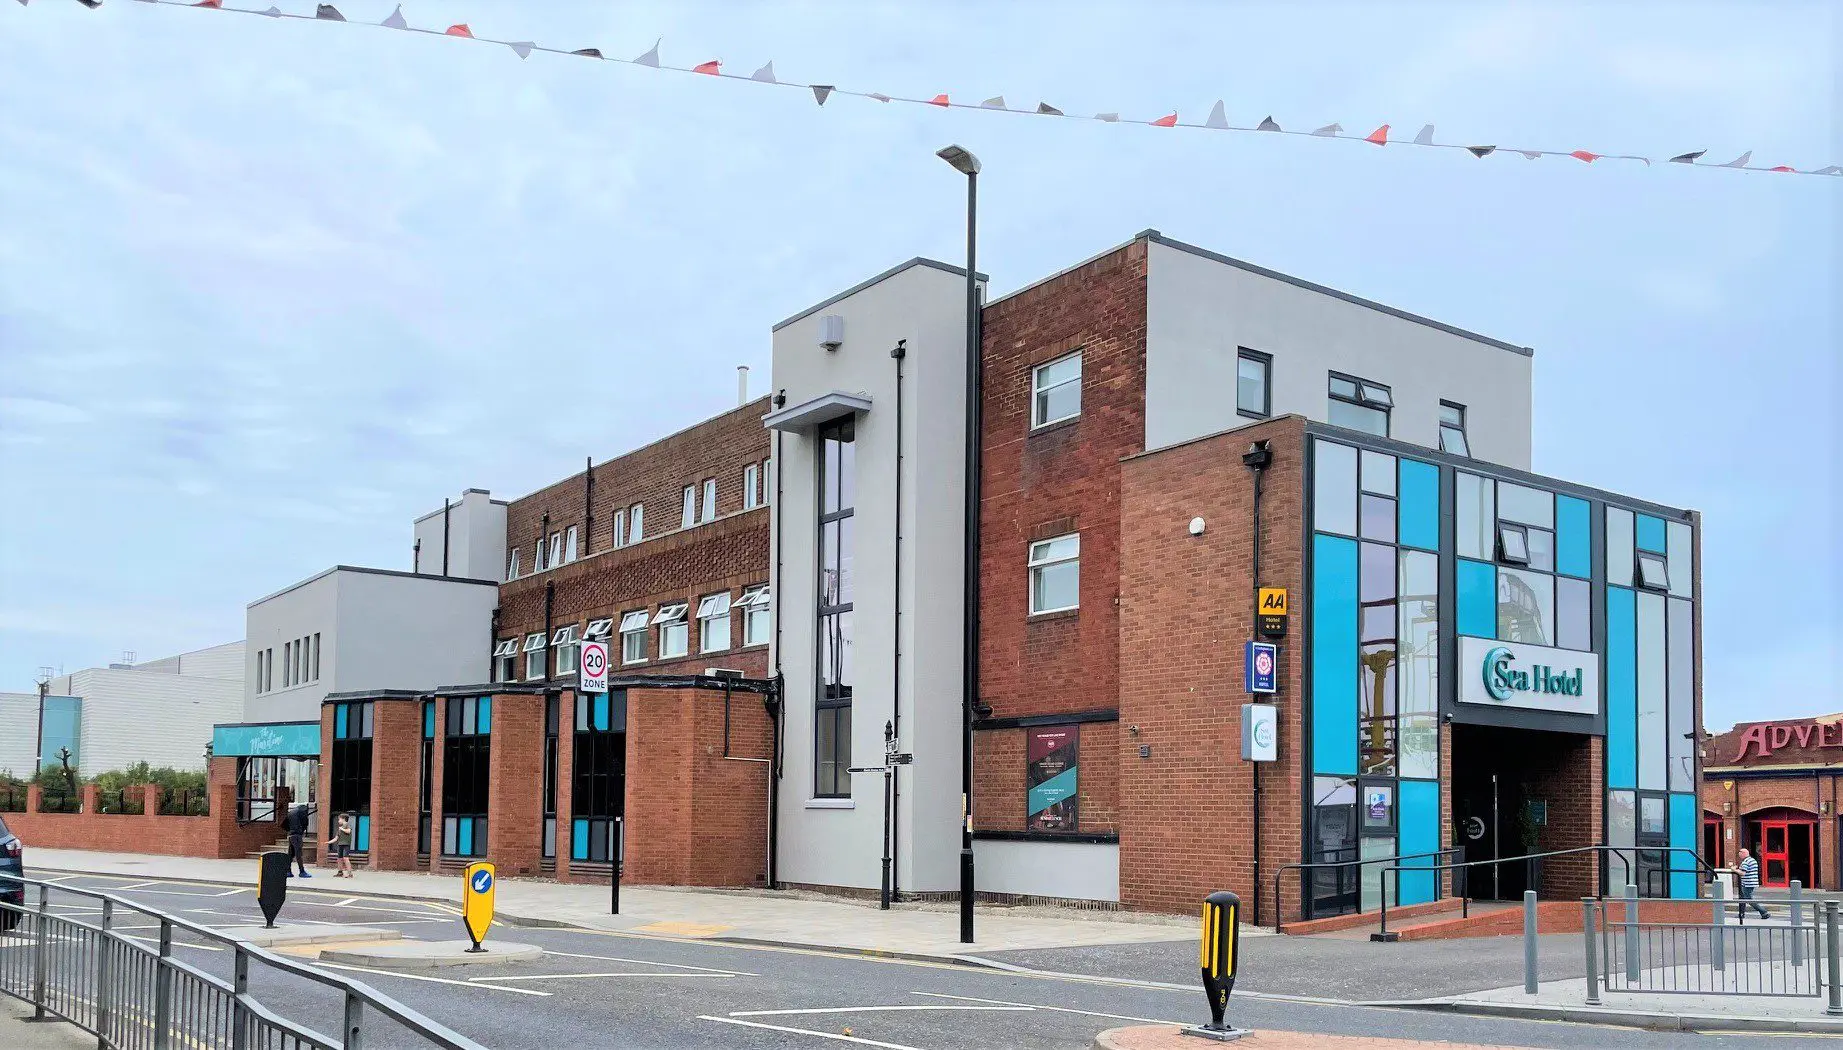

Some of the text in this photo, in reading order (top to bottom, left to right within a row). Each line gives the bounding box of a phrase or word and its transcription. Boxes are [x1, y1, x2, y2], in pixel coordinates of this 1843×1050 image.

[1263, 593, 1284, 609] AA
[586, 653, 603, 668] 20
[584, 679, 606, 688] ZONE
[1494, 660, 1583, 697] Sea Hotel
[1729, 719, 1843, 763] ADVE
